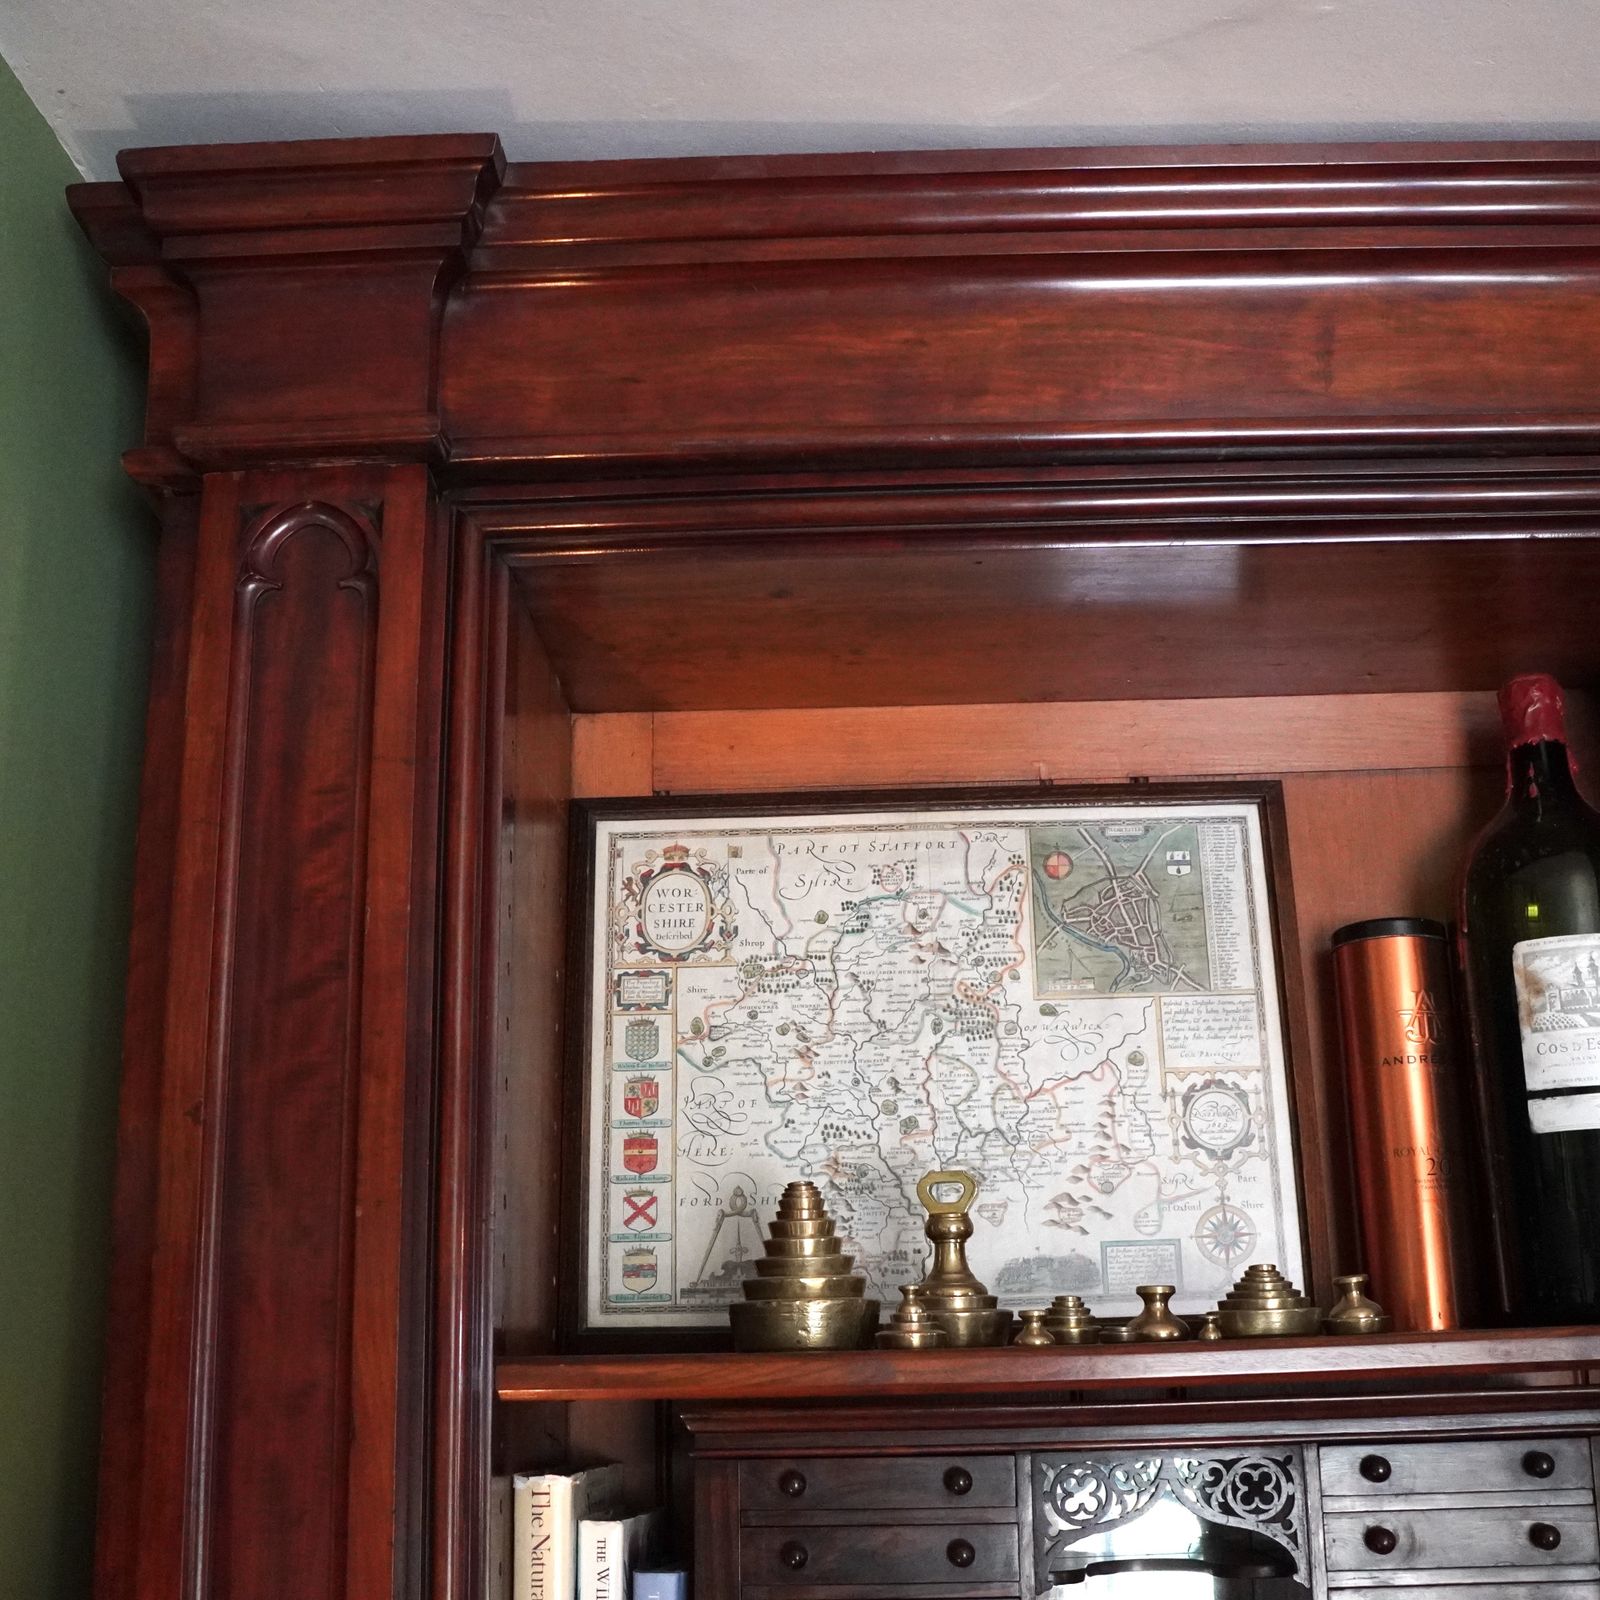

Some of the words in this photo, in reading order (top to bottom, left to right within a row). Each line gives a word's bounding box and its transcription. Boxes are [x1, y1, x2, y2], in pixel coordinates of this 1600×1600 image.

[776, 839, 829, 855] PART
[736, 867, 757, 875] Parte
[758, 865, 769, 875] of
[647, 902, 705, 914] CESTER
[653, 917, 696, 929] SHIRE
[738, 938, 766, 948] Shrop
[686, 984, 708, 994] Shire
[1382, 1055, 1440, 1067] ANDRE
[738, 1099, 758, 1109] OF
[1237, 1174, 1257, 1182] Part
[680, 1197, 724, 1207] FORD
[748, 1194, 778, 1207] SHI
[530, 1484, 552, 1528] The
[596, 1537, 607, 1563] THE
